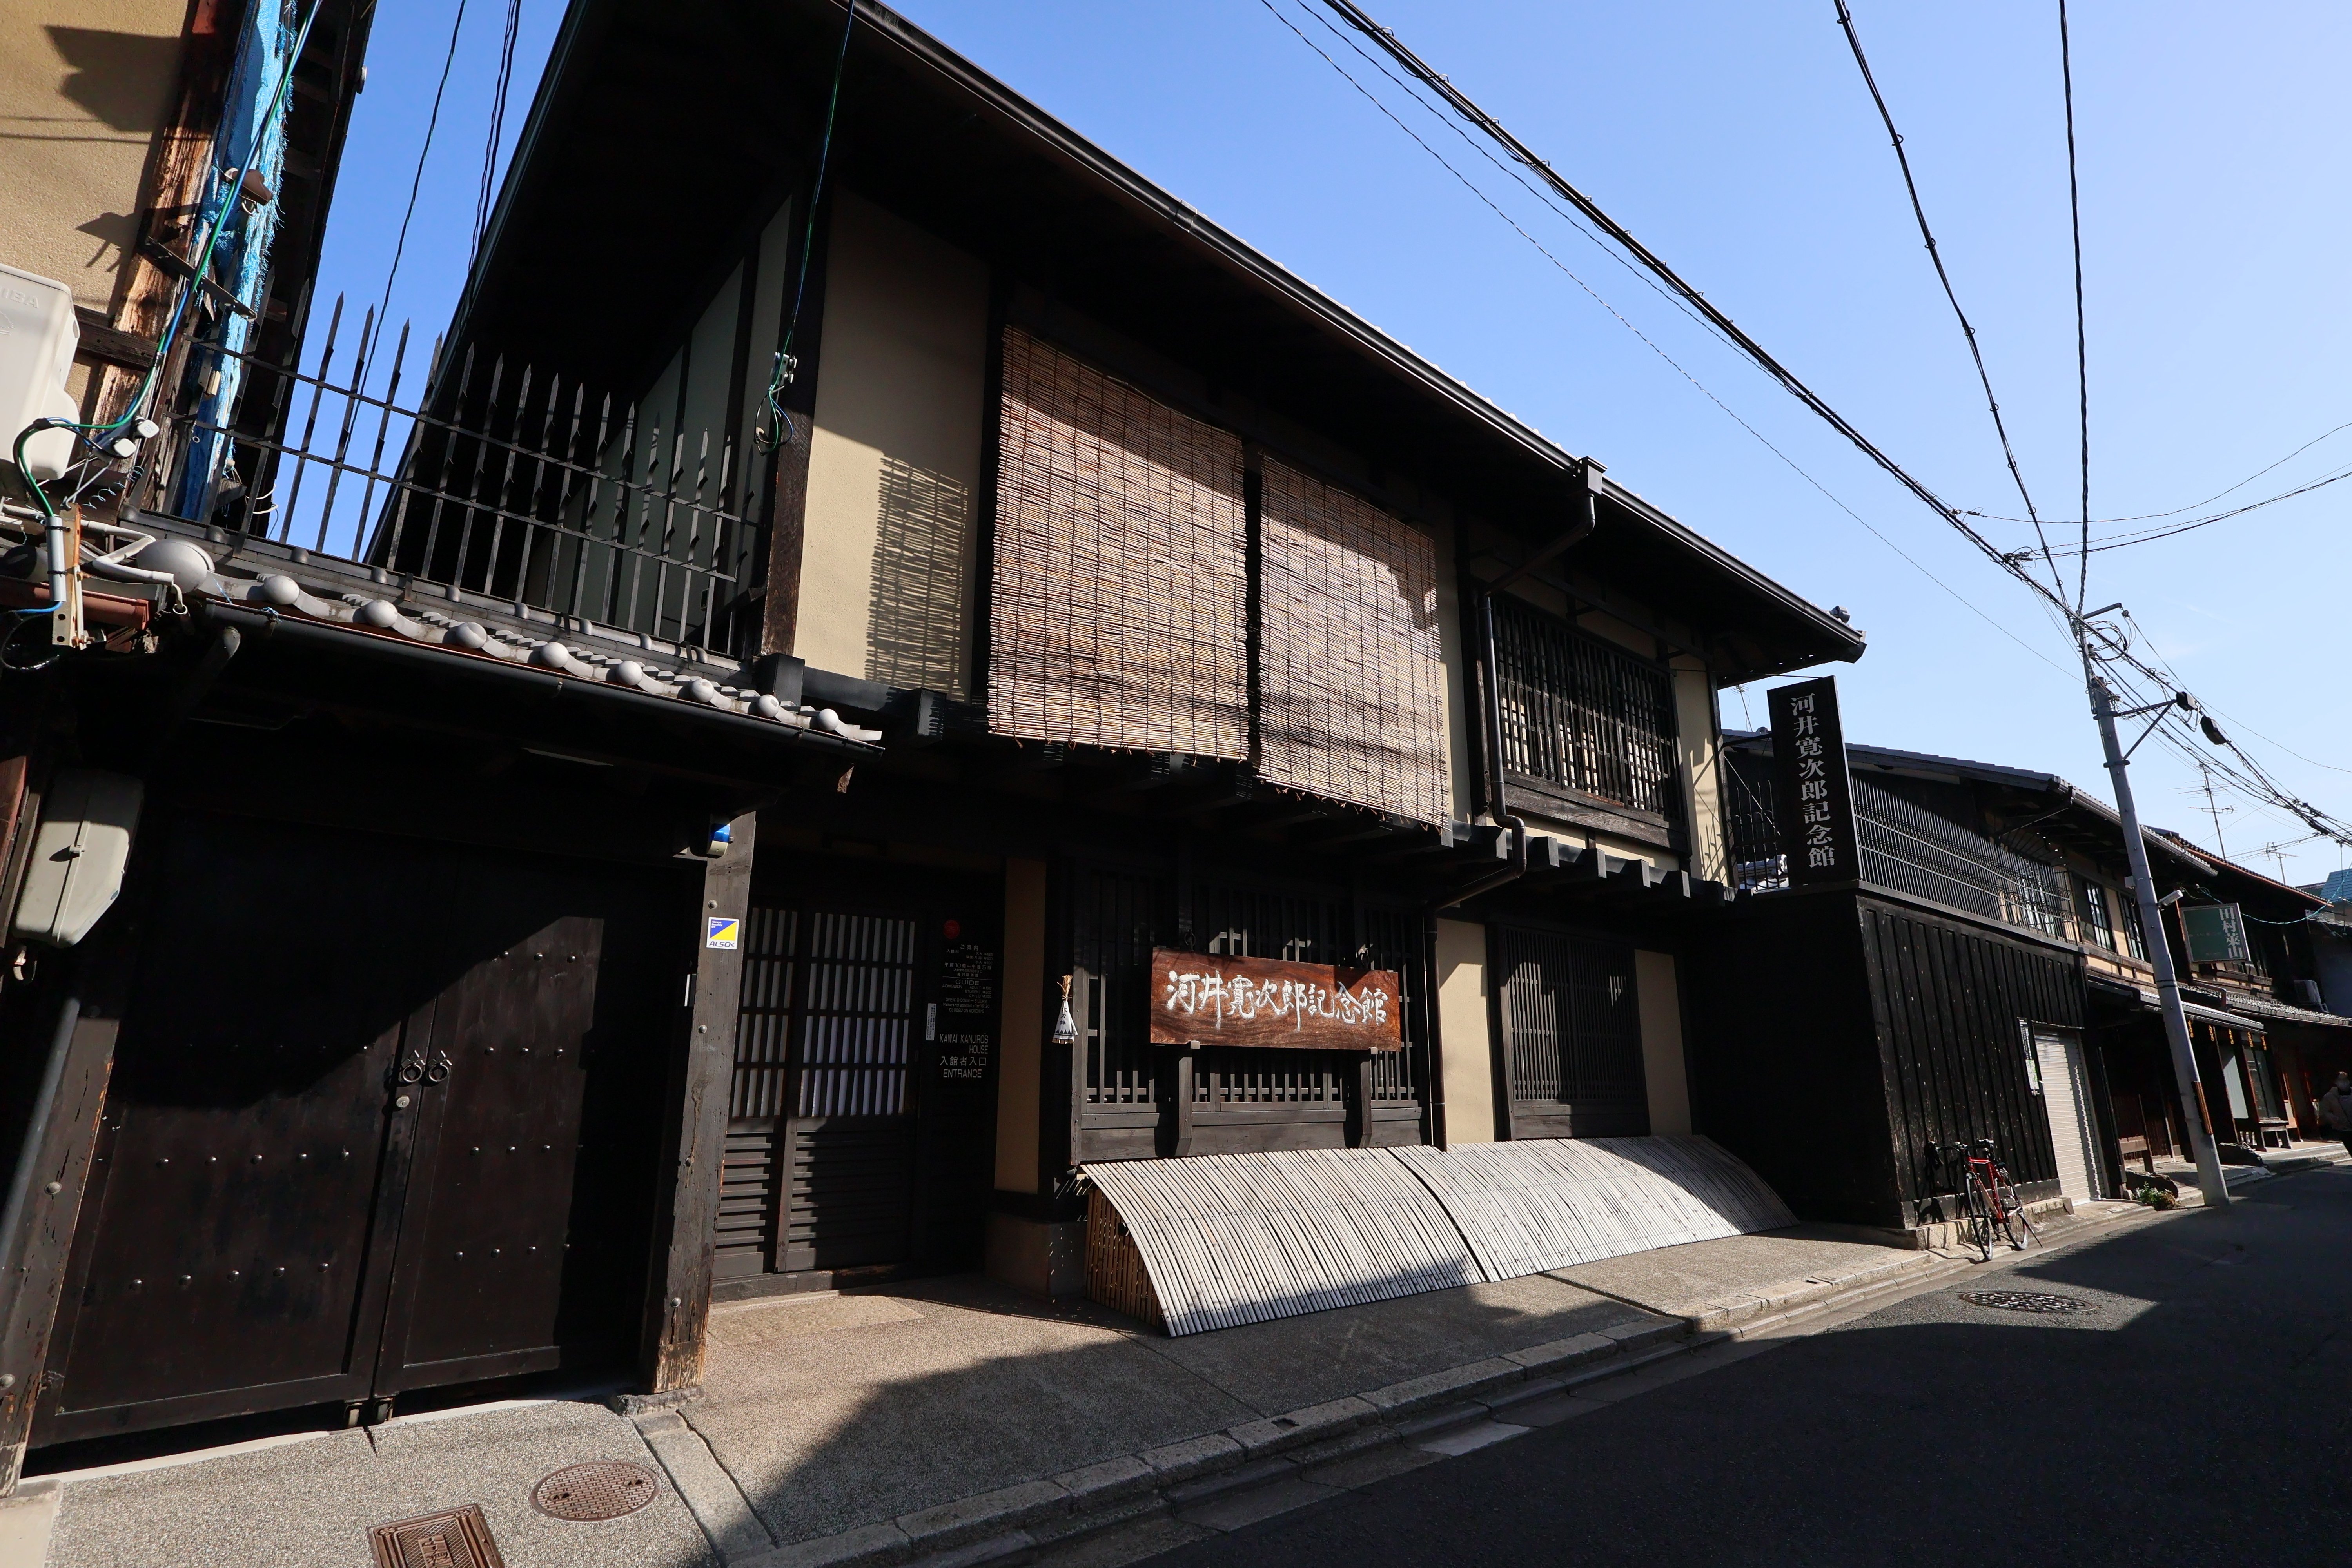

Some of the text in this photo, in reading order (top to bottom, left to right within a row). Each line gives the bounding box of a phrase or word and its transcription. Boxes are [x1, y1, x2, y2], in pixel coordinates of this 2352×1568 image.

[0, 287, 39, 308] IBA
[939, 1034, 958, 1043] KAWAI
[969, 1045, 988, 1054] HOUSE
[940, 1056, 987, 1066] 入館者入口
[943, 1069, 982, 1078] ENTRANCE
